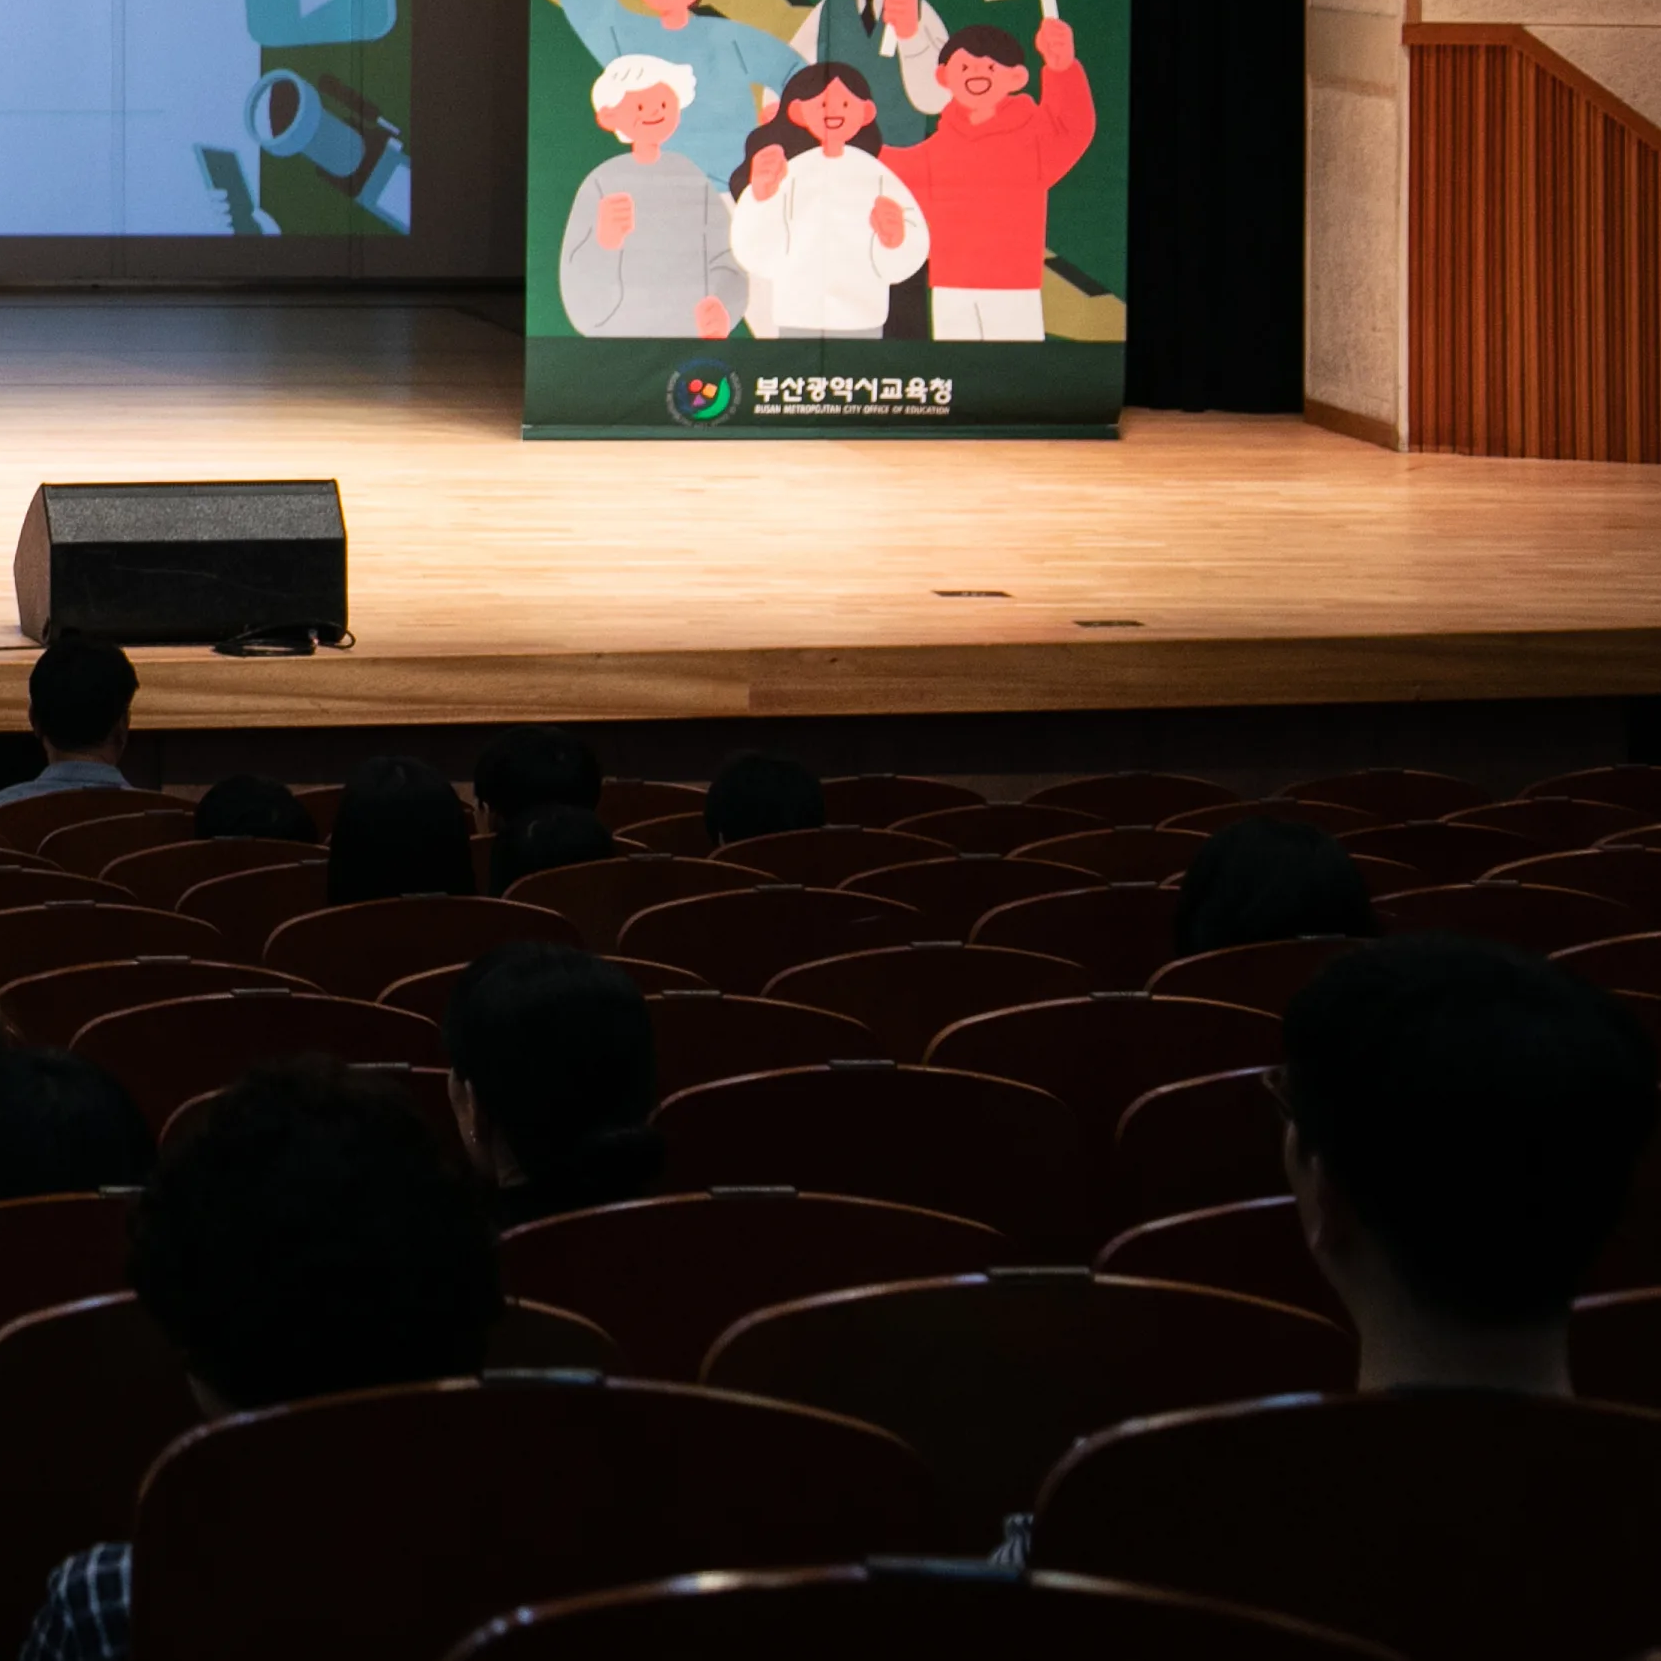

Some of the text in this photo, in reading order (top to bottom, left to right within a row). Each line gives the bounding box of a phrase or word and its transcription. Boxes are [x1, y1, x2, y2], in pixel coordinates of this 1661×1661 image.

[754, 376, 953, 404] 부산광역시교육청
[843, 404, 862, 415] CITY
[863, 405, 890, 415] OFFICE
[892, 405, 904, 415] OF
